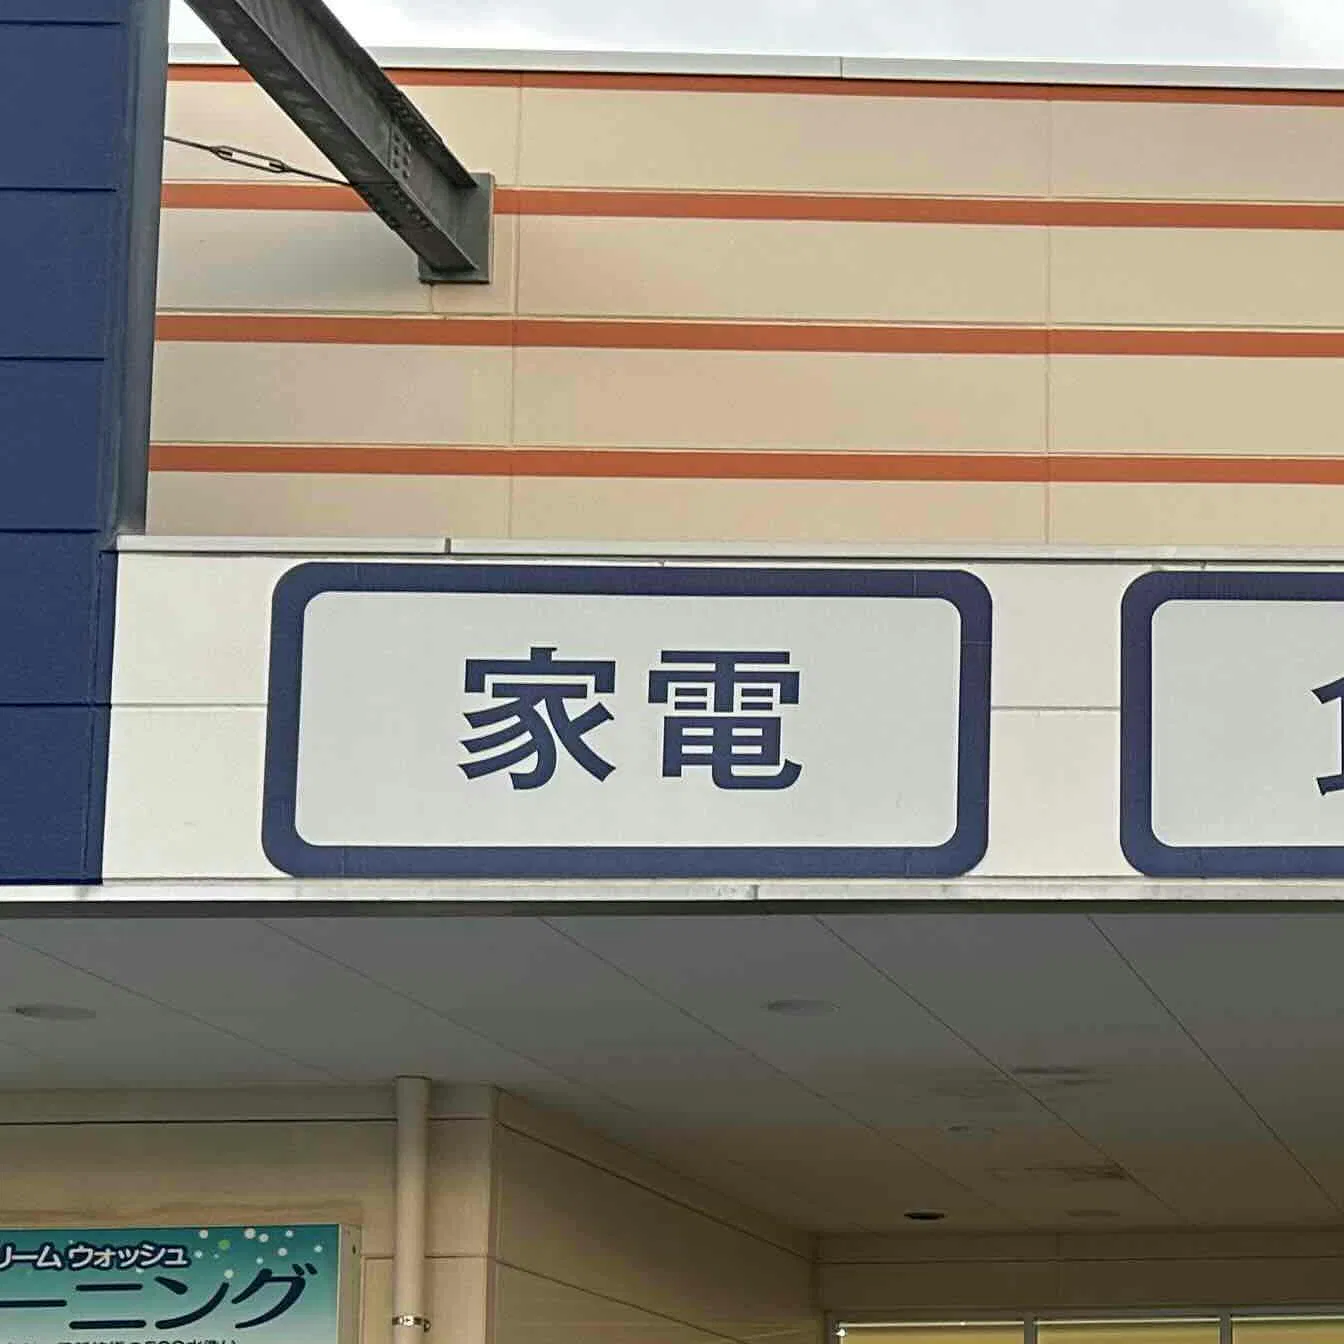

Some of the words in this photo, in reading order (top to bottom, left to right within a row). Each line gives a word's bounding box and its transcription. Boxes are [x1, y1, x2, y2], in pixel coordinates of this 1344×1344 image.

[459, 647, 802, 790] 家電
[68, 1242, 188, 1268] ウォッシュ
[0, 1263, 318, 1330] ーニング
